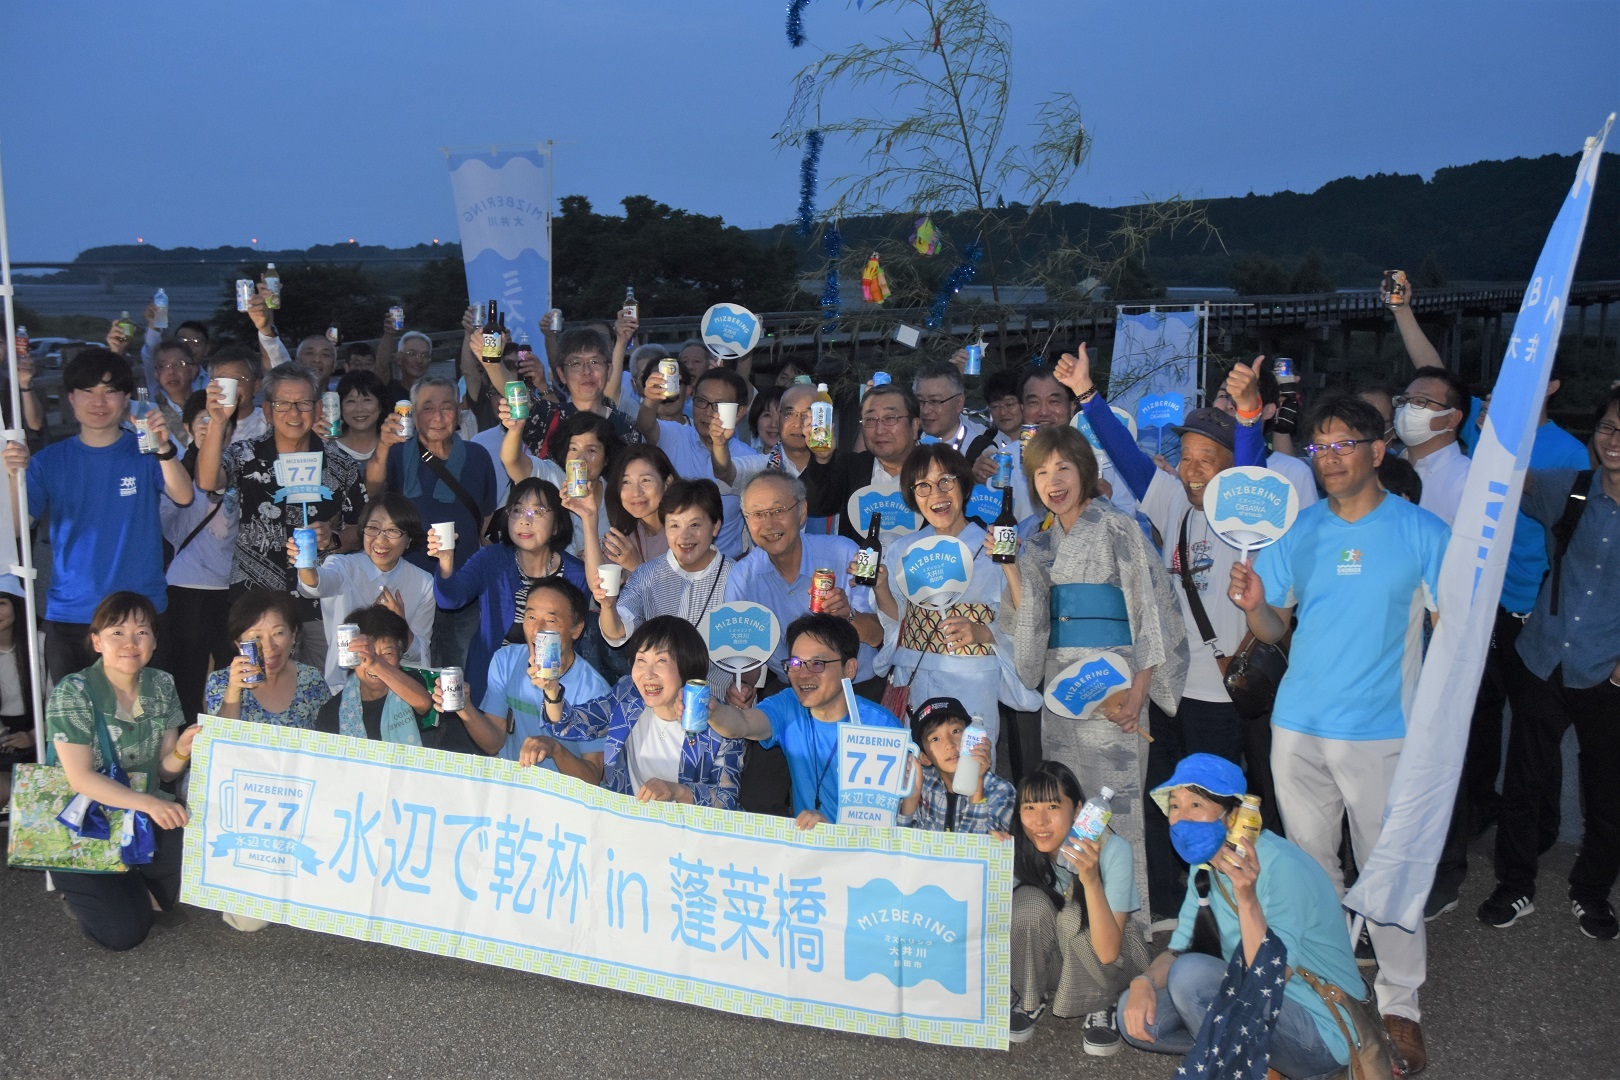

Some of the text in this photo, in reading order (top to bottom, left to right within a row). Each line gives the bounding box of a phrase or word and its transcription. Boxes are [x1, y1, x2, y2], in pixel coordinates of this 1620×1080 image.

[287, 466, 317, 482] 7.7
[1223, 486, 1282, 506] MIZBERING
[863, 500, 911, 515] MIZBERING
[998, 531, 1016, 544] 193
[909, 552, 957, 574] MIZBERING
[714, 616, 766, 632] MIZBERING
[1065, 668, 1110, 701] MIZBERING
[846, 734, 901, 749] MIZBERING
[846, 751, 897, 786] 7.7
[243, 783, 304, 798] MIZBERING
[841, 791, 897, 810] 水辺で乾杯
[244, 798, 300, 831] 7.7
[847, 810, 882, 822] MIZCAN
[236, 835, 297, 853] 水辺で乾杯
[248, 852, 286, 864] MIZCAN
[328, 791, 828, 974] 水辺で乾杯 in 蓬莱橋
[857, 908, 956, 943] MIZBERING
[884, 934, 933, 946] ミズベリング
[889, 946, 927, 958] 大井川
